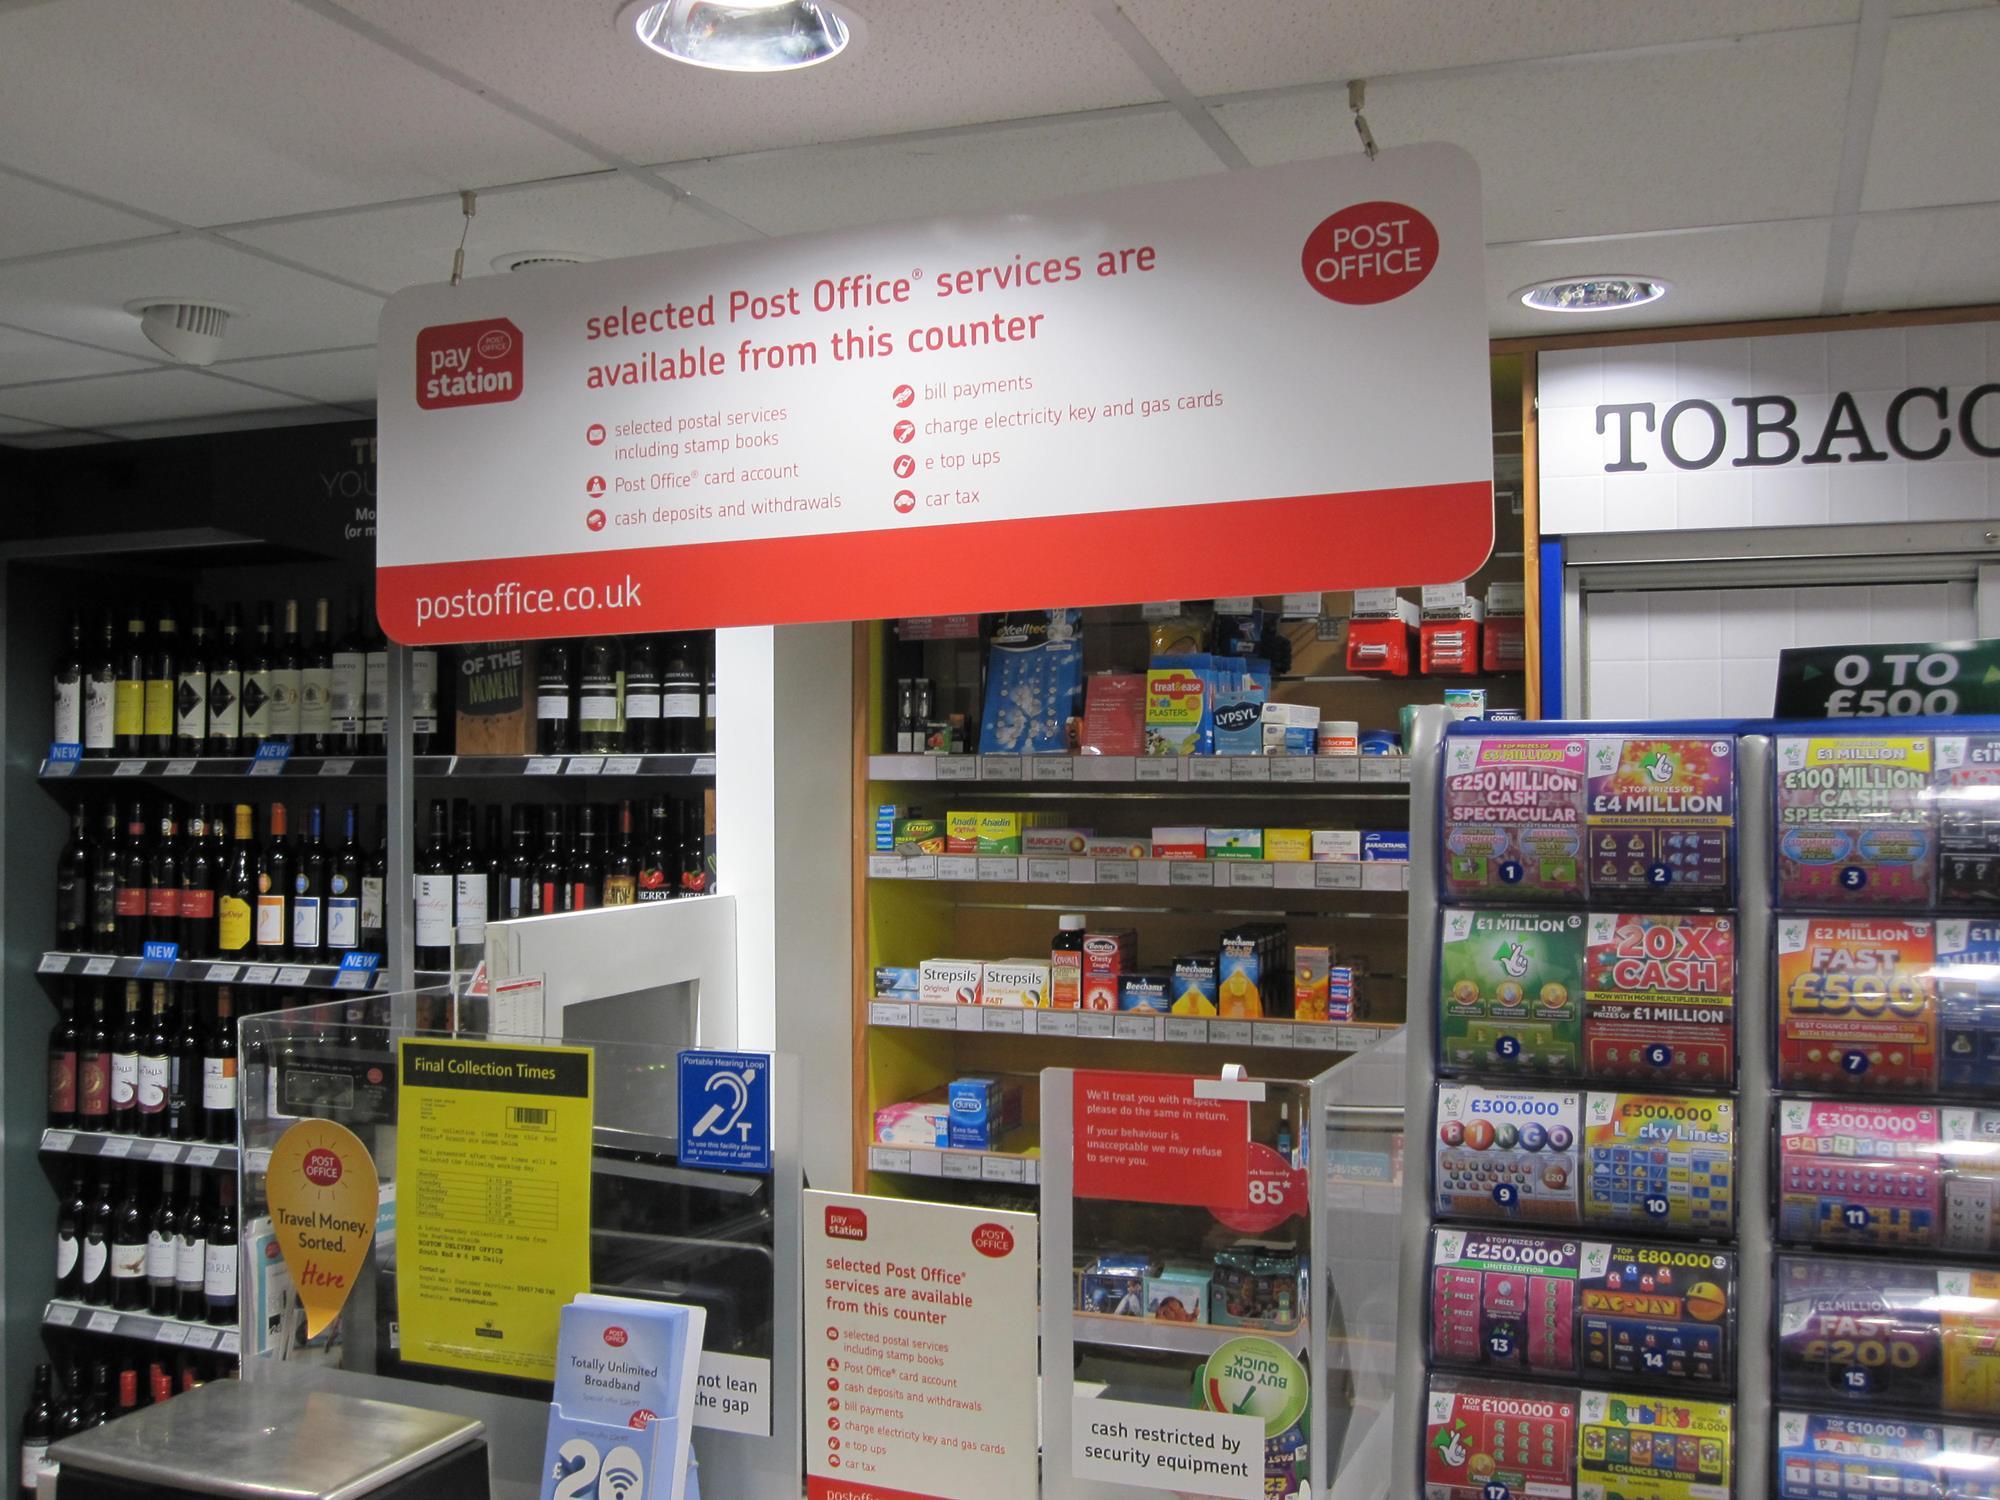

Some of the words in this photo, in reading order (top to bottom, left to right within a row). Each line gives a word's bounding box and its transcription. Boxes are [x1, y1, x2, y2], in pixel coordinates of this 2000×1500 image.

[1334, 220, 1410, 252] POST
[1315, 249, 1422, 282] OFFICE
[587, 306, 715, 340] selected
[729, 287, 799, 323] Post
[936, 254, 1081, 299] services
[1096, 243, 1156, 276] are
[587, 348, 725, 389] available
[738, 340, 816, 373] from
[832, 325, 893, 362] this
[908, 311, 1044, 353] counter
[431, 345, 471, 375] pay
[427, 366, 512, 398] station
[924, 382, 946, 401] bill
[952, 375, 1032, 402] payments
[615, 418, 672, 438] selected
[678, 413, 722, 439] postal
[727, 408, 787, 426] services
[925, 415, 978, 439] charge
[984, 407, 1062, 431] electricity
[1068, 404, 1096, 425] key
[1102, 398, 1134, 419] and
[1140, 397, 1170, 418] gas
[1177, 390, 1224, 412] cards
[615, 440, 679, 461] including
[684, 436, 730, 457] stamp
[736, 431, 779, 450] books
[925, 458, 934, 470] e
[940, 452, 966, 475] top
[971, 450, 1000, 471] ups
[615, 475, 645, 493] Post
[704, 467, 736, 486] card
[741, 463, 798, 482] account
[926, 493, 950, 508] car
[956, 488, 980, 505] tax
[615, 509, 648, 526] cash
[652, 504, 713, 528] deposits
[718, 499, 746, 518] and
[751, 493, 841, 515] withdrawals
[416, 574, 642, 626] postoffice.co.uk
[462, 657, 485, 675] OF
[488, 651, 522, 671] THE
[1883, 654, 1959, 685] TO
[469, 669, 518, 705] MOMENT
[1150, 708, 1187, 717] PLASTERS
[1824, 689, 1959, 718] £500
[1216, 708, 1257, 724] LYPSYL
[52, 747, 79, 759] NEW
[259, 745, 288, 757] NEW
[1452, 772, 1496, 791] £250
[1500, 771, 1576, 791] MILLION
[1785, 769, 1834, 788] £100
[1838, 767, 1924, 788] MILLION
[1487, 791, 1537, 805] CASH
[1594, 796, 1621, 812] £4
[1626, 796, 1722, 812] MILLION
[1820, 790, 1888, 807] CASH
[1453, 808, 1576, 821] SPECTACULAR
[1477, 918, 1492, 930] £1
[1497, 919, 1564, 932] MILLION
[1814, 928, 1832, 940] £2
[1837, 928, 1908, 940] MILLION
[1223, 938, 1254, 947] Beechams
[1615, 924, 1715, 960] 20X
[147, 946, 174, 959] NEW
[346, 955, 376, 968] NEW
[1813, 948, 1898, 971] FAST
[924, 968, 976, 983] Strepsils
[1176, 964, 1214, 973] Beechams
[1613, 959, 1717, 992] CASH
[988, 970, 1042, 986] Strepsils
[1126, 982, 1164, 990] Beechams
[1633, 1008, 1650, 1019] £1
[1654, 1008, 1723, 1023] MILLION
[415, 1057, 444, 1073] Final
[448, 1059, 512, 1078] Collection
[516, 1064, 555, 1080] Times
[684, 1057, 713, 1066] Portable
[715, 1059, 744, 1068] Hearing
[746, 1061, 764, 1069] Loop
[955, 1101, 979, 1110] durex
[1087, 1089, 1109, 1099] We'll
[1113, 1092, 1135, 1102] treat
[1138, 1095, 1154, 1104] you
[1158, 1094, 1179, 1104] with
[1087, 1105, 1116, 1115] please
[1120, 1106, 1132, 1115] do
[1135, 1107, 1150, 1116] the
[1154, 1110, 1179, 1118] same
[1183, 1109, 1192, 1118] in
[1196, 1112, 1228, 1121] return.
[1471, 1100, 1559, 1116] £300,000
[1622, 1104, 1712, 1122] £300,000
[1087, 1125, 1094, 1134] If
[1097, 1128, 1117, 1138] your
[1121, 1127, 1168, 1139] behaviour
[1171, 1130, 1179, 1140] is
[1087, 1140, 1148, 1152] unacceptable
[1152, 1145, 1165, 1153] we
[1169, 1146, 1188, 1156] may
[1192, 1146, 1222, 1157] refuse
[312, 1156, 334, 1166] POST
[1087, 1153, 1096, 1162] to
[1099, 1156, 1126, 1164] serve
[1129, 1157, 1148, 1166] you.
[307, 1166, 338, 1178] OFFICE
[278, 1208, 315, 1227] Travel
[320, 1214, 368, 1238] Money.
[831, 1214, 847, 1226] pay
[829, 1225, 863, 1237] station
[981, 1230, 1004, 1240] POST
[299, 1233, 346, 1252] Sorted.
[976, 1239, 1009, 1250] OFFICE
[1466, 1243, 1562, 1265] £250,000
[302, 1260, 345, 1288] Here
[826, 1257, 880, 1275] selected
[887, 1263, 916, 1279] Post
[825, 1279, 879, 1295] services
[884, 1286, 905, 1298] are
[911, 1288, 972, 1308] available
[827, 1297, 858, 1312] from
[864, 1302, 888, 1318] this
[894, 1308, 946, 1325] counter
[571, 1356, 604, 1373] Totally
[608, 1362, 658, 1378] Unlimited
[1224, 1365, 1254, 1381] ONE
[1235, 1355, 1279, 1373] QUICK
[585, 1375, 640, 1392] Broadband
[726, 1375, 757, 1393] lean
[1258, 1376, 1287, 1389] BUY
[722, 1399, 749, 1414] gap
[1091, 1422, 1128, 1438] cash
[1135, 1428, 1215, 1448] restricted
[1222, 1435, 1240, 1454] by
[1085, 1446, 1150, 1466] security
[1157, 1453, 1248, 1477] equipment
